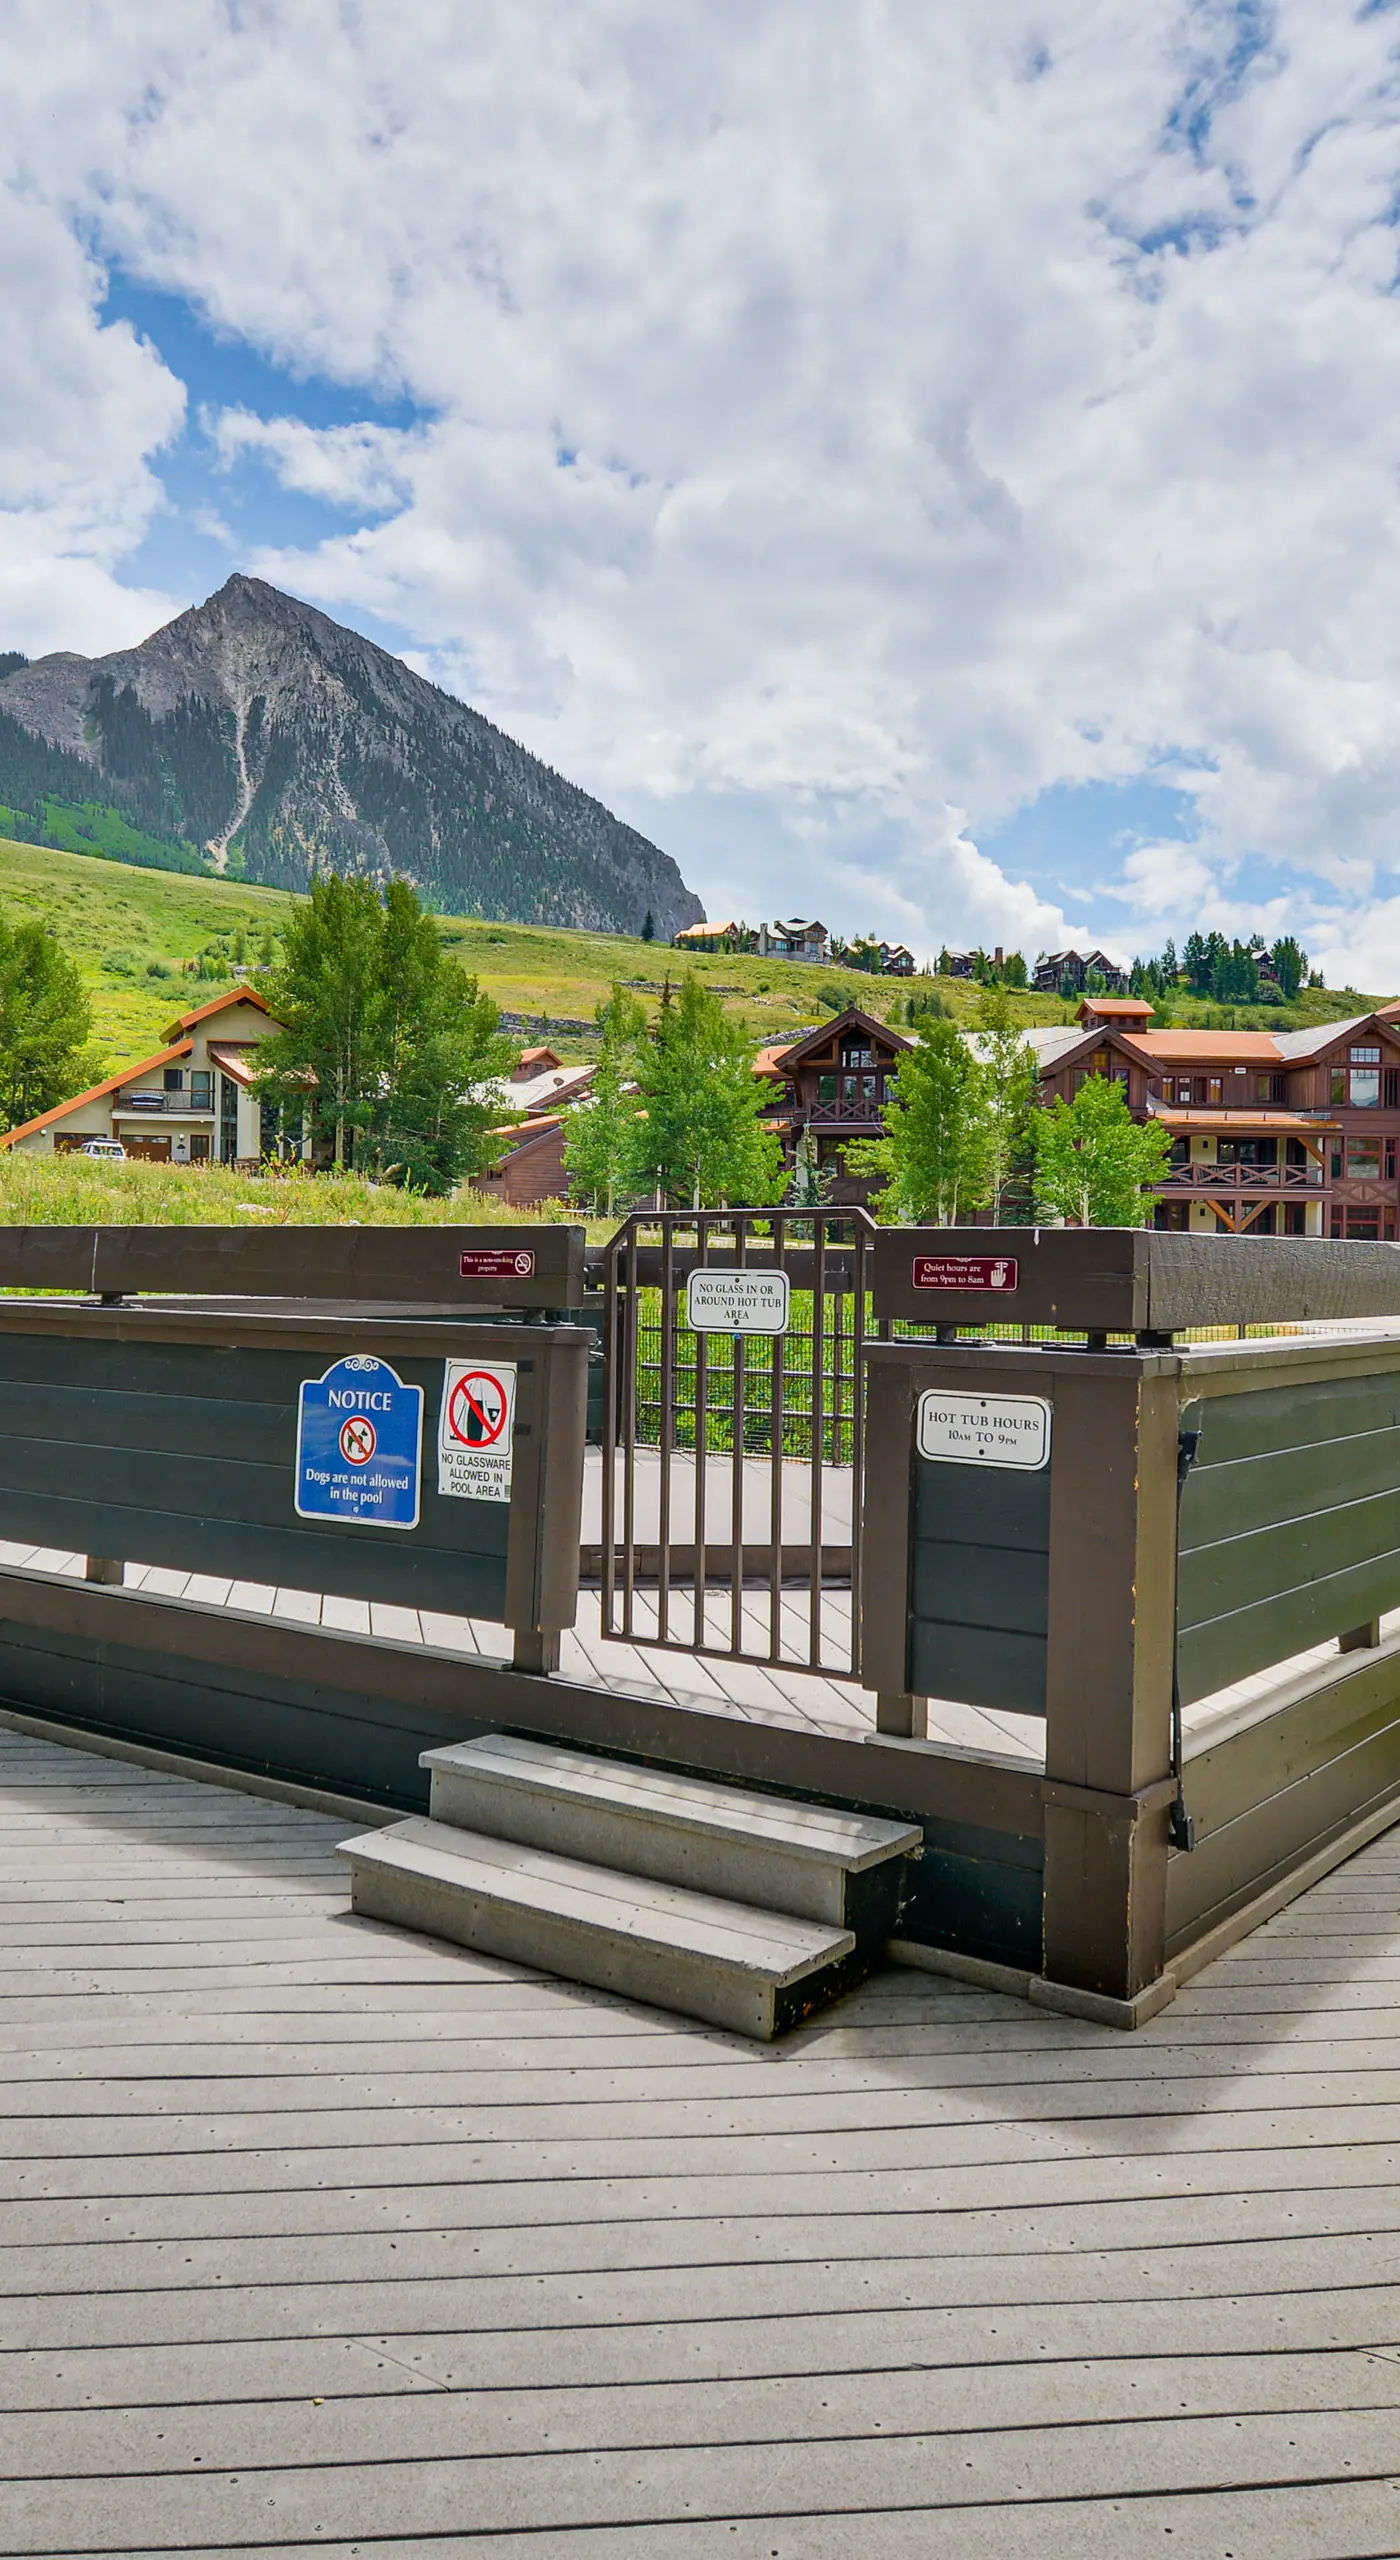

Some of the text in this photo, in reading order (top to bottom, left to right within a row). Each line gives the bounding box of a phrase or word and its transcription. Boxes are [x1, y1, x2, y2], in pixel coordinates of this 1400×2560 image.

[923, 1262, 945, 1272] Quiet
[946, 1263, 968, 1272] hours
[920, 1273, 938, 1283] from
[939, 1274, 957, 1285] 9pm
[958, 1275, 967, 1284] to
[699, 1283, 774, 1295] NO GLASS IN OR
[694, 1296, 782, 1308] AROUND HOT TUB
[724, 1309, 750, 1319] AREA
[328, 1389, 392, 1411] NOTICE
[929, 1411, 1040, 1431] HOT TUB HOURS
[948, 1429, 1017, 1446] 10AM TO 9PM
[441, 1453, 511, 1471] NO GLASSWARE
[305, 1468, 409, 1490] Dogs are not allowed
[449, 1467, 503, 1484] ALLOWED IN
[329, 1486, 384, 1506] in the pool
[451, 1481, 501, 1497] POOL AREA
